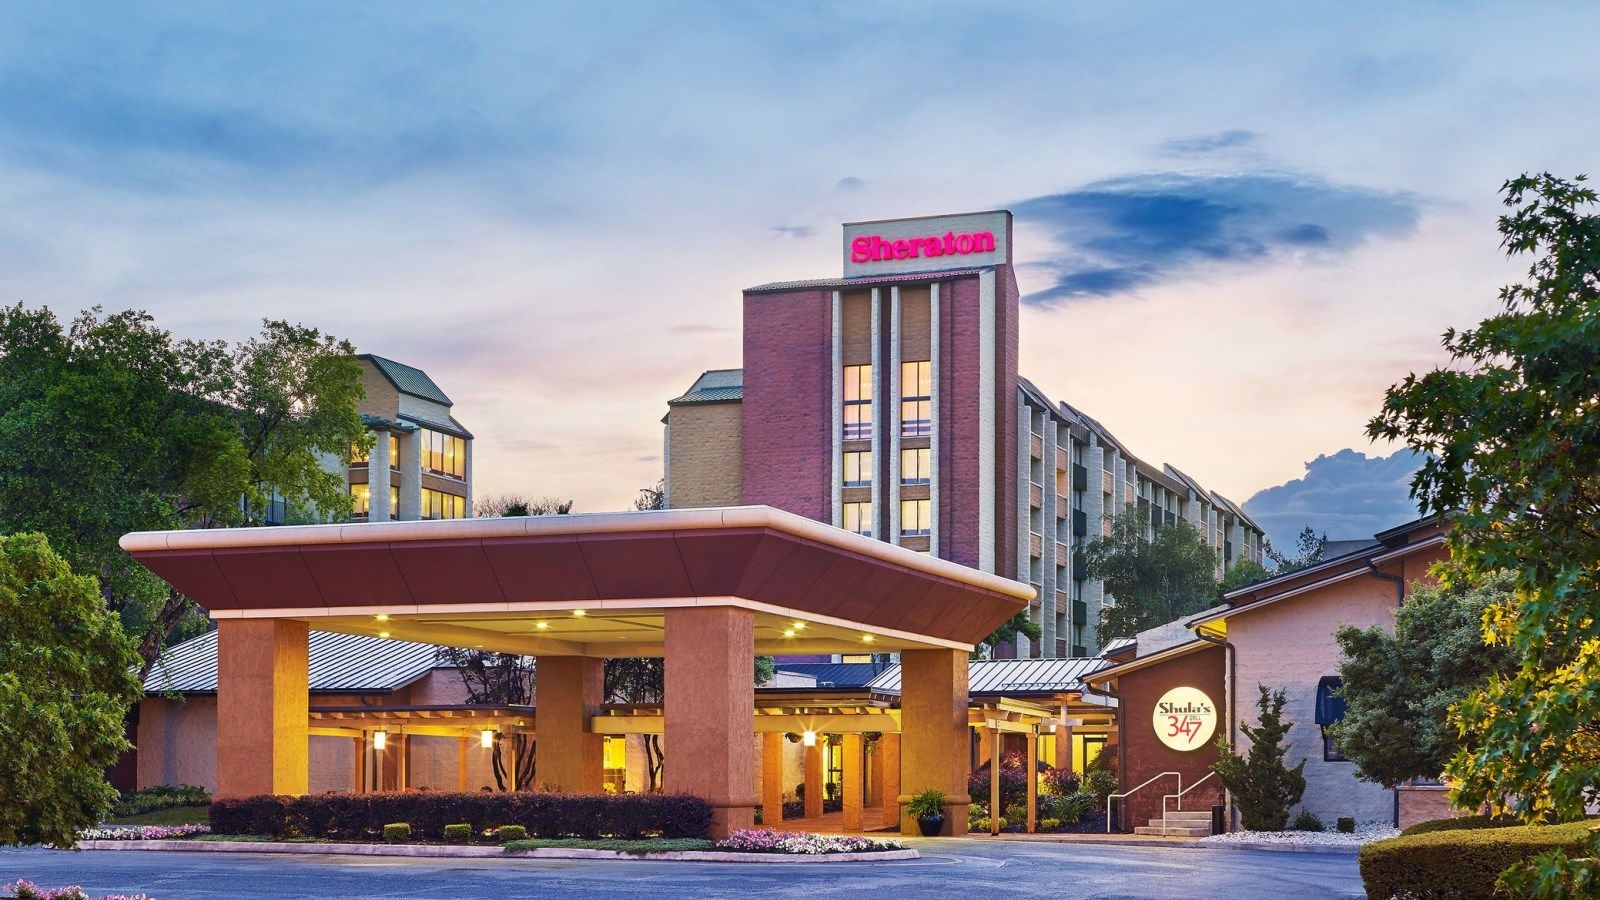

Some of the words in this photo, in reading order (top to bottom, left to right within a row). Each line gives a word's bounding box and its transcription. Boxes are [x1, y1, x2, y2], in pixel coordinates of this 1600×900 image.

[851, 231, 995, 263] Sheraton
[1158, 702, 1212, 714] Shula's
[1167, 715, 1202, 744] 347
